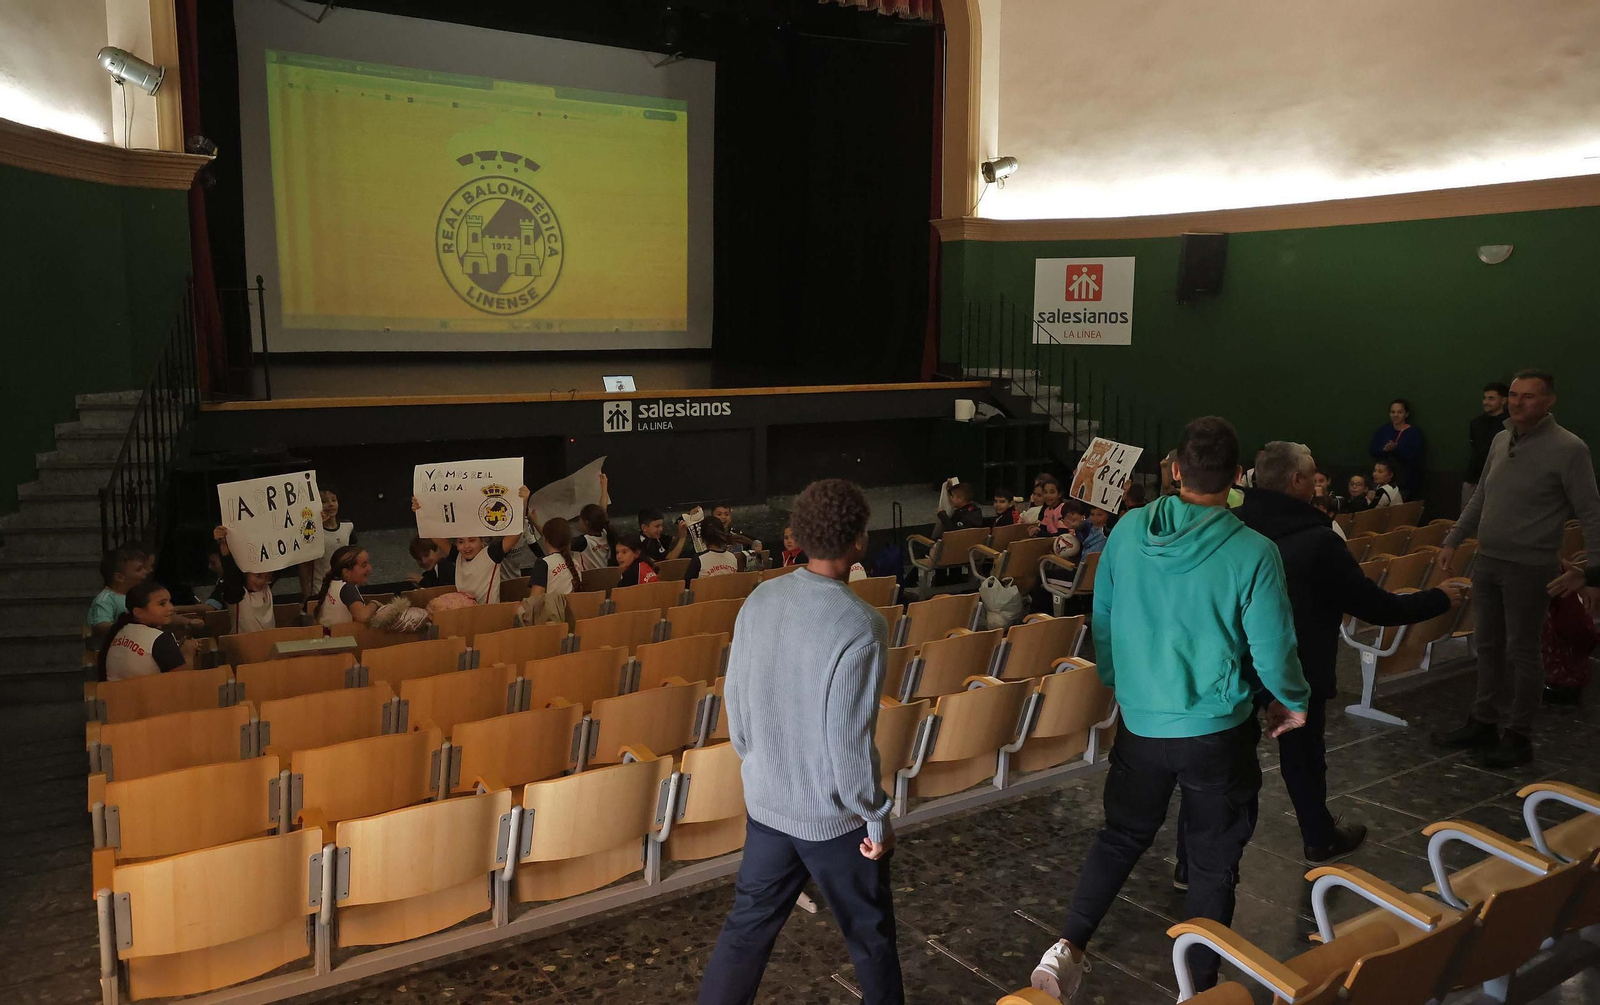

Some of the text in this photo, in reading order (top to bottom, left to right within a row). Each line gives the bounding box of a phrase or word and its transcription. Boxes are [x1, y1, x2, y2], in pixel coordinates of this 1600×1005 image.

[442, 182, 560, 258] REAL BALOMPÉDICA
[491, 242, 513, 251] 1912
[466, 285, 540, 310] LINENSE
[1037, 308, 1129, 324] salesianos
[1063, 331, 1075, 339] LA
[638, 399, 732, 419] salesianos
[638, 422, 649, 431] LA
[112, 635, 145, 656] esianos
